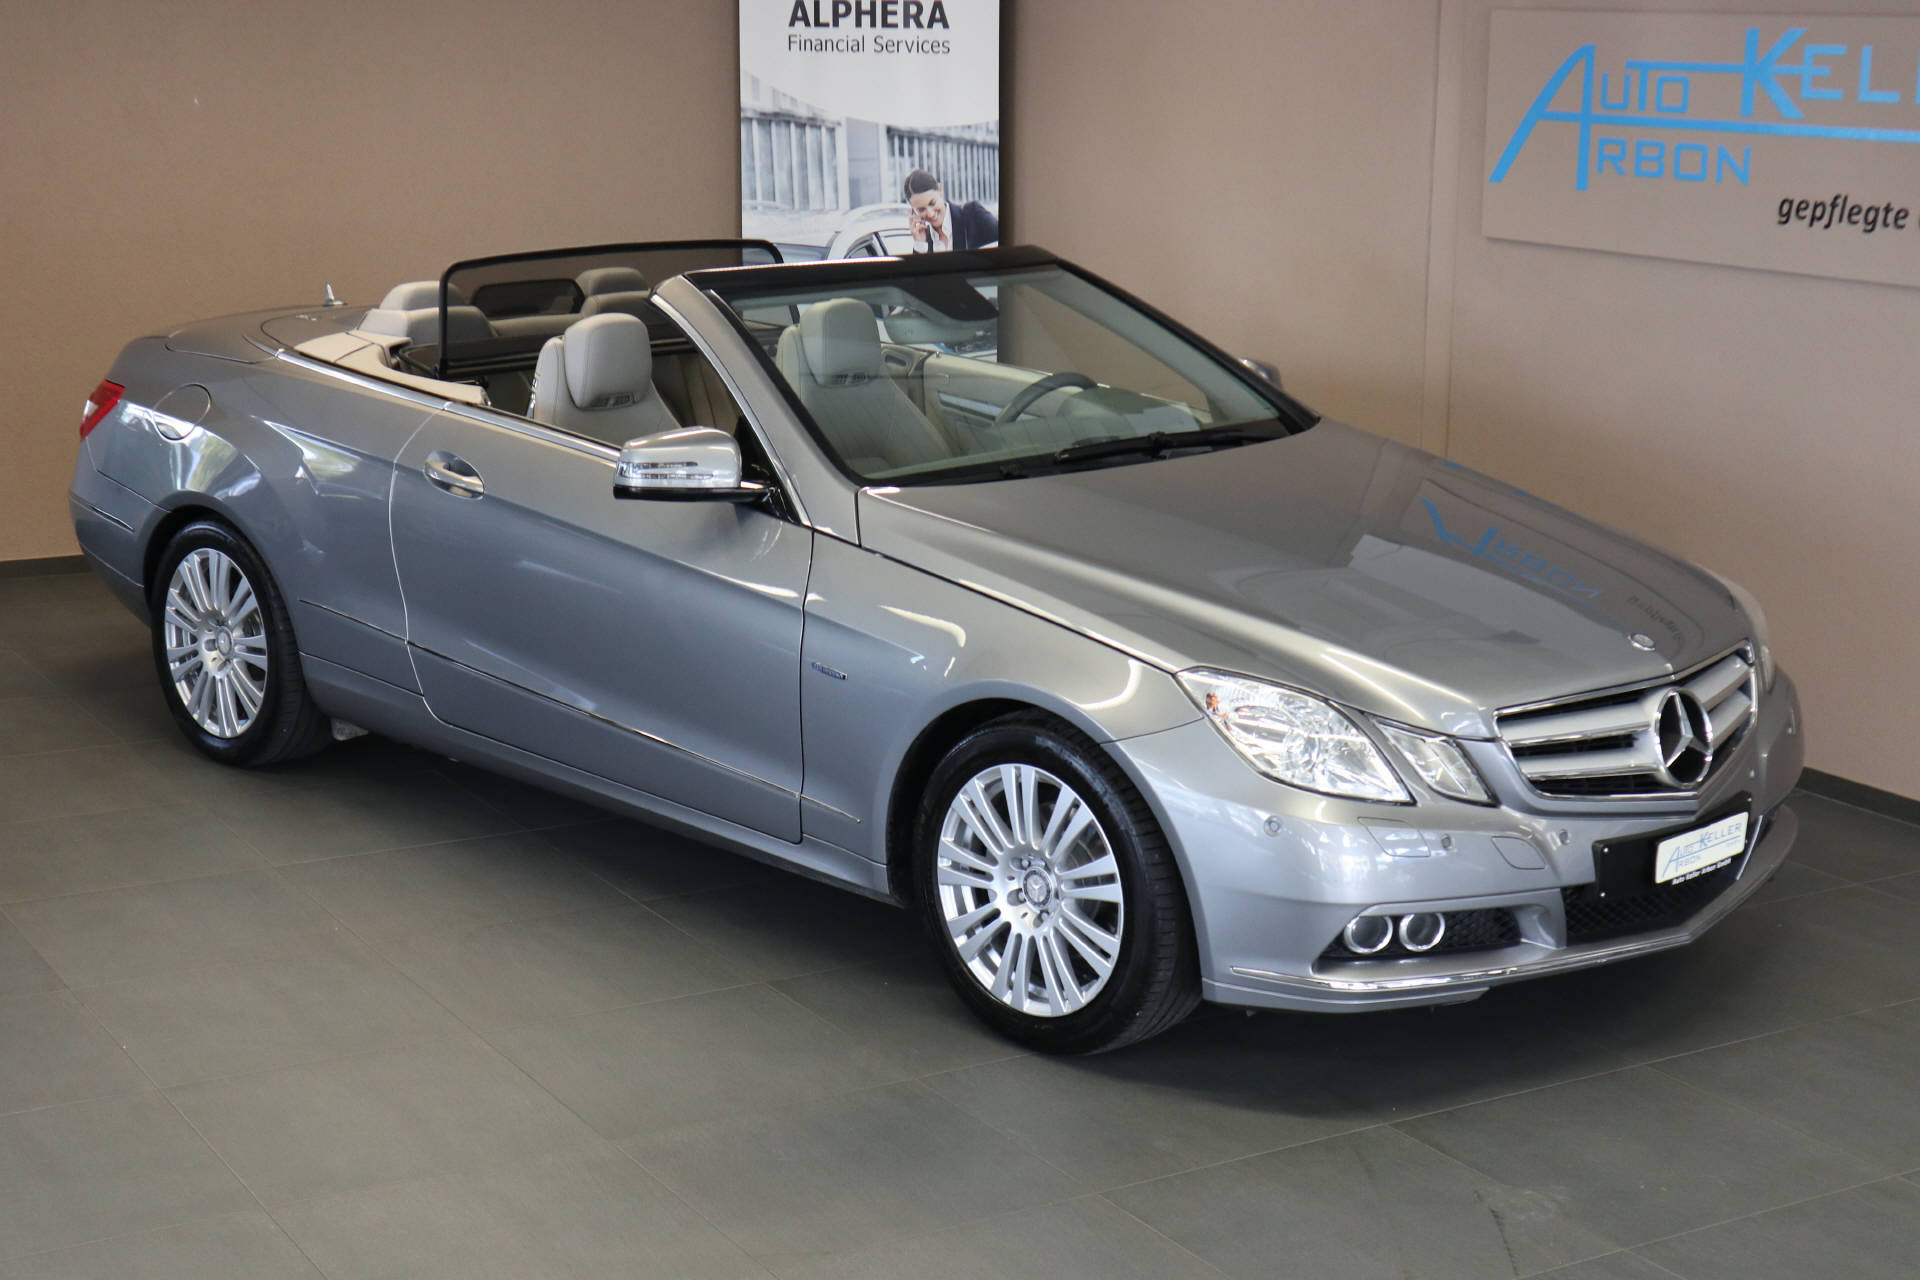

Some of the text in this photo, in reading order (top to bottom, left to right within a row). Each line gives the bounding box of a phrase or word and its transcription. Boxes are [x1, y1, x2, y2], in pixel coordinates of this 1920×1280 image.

[788, 0, 950, 29] ALPHERA
[788, 34, 951, 54] Financial Services
[1741, 27, 1920, 119] KEL
[1777, 195, 1909, 233] gepflegte
